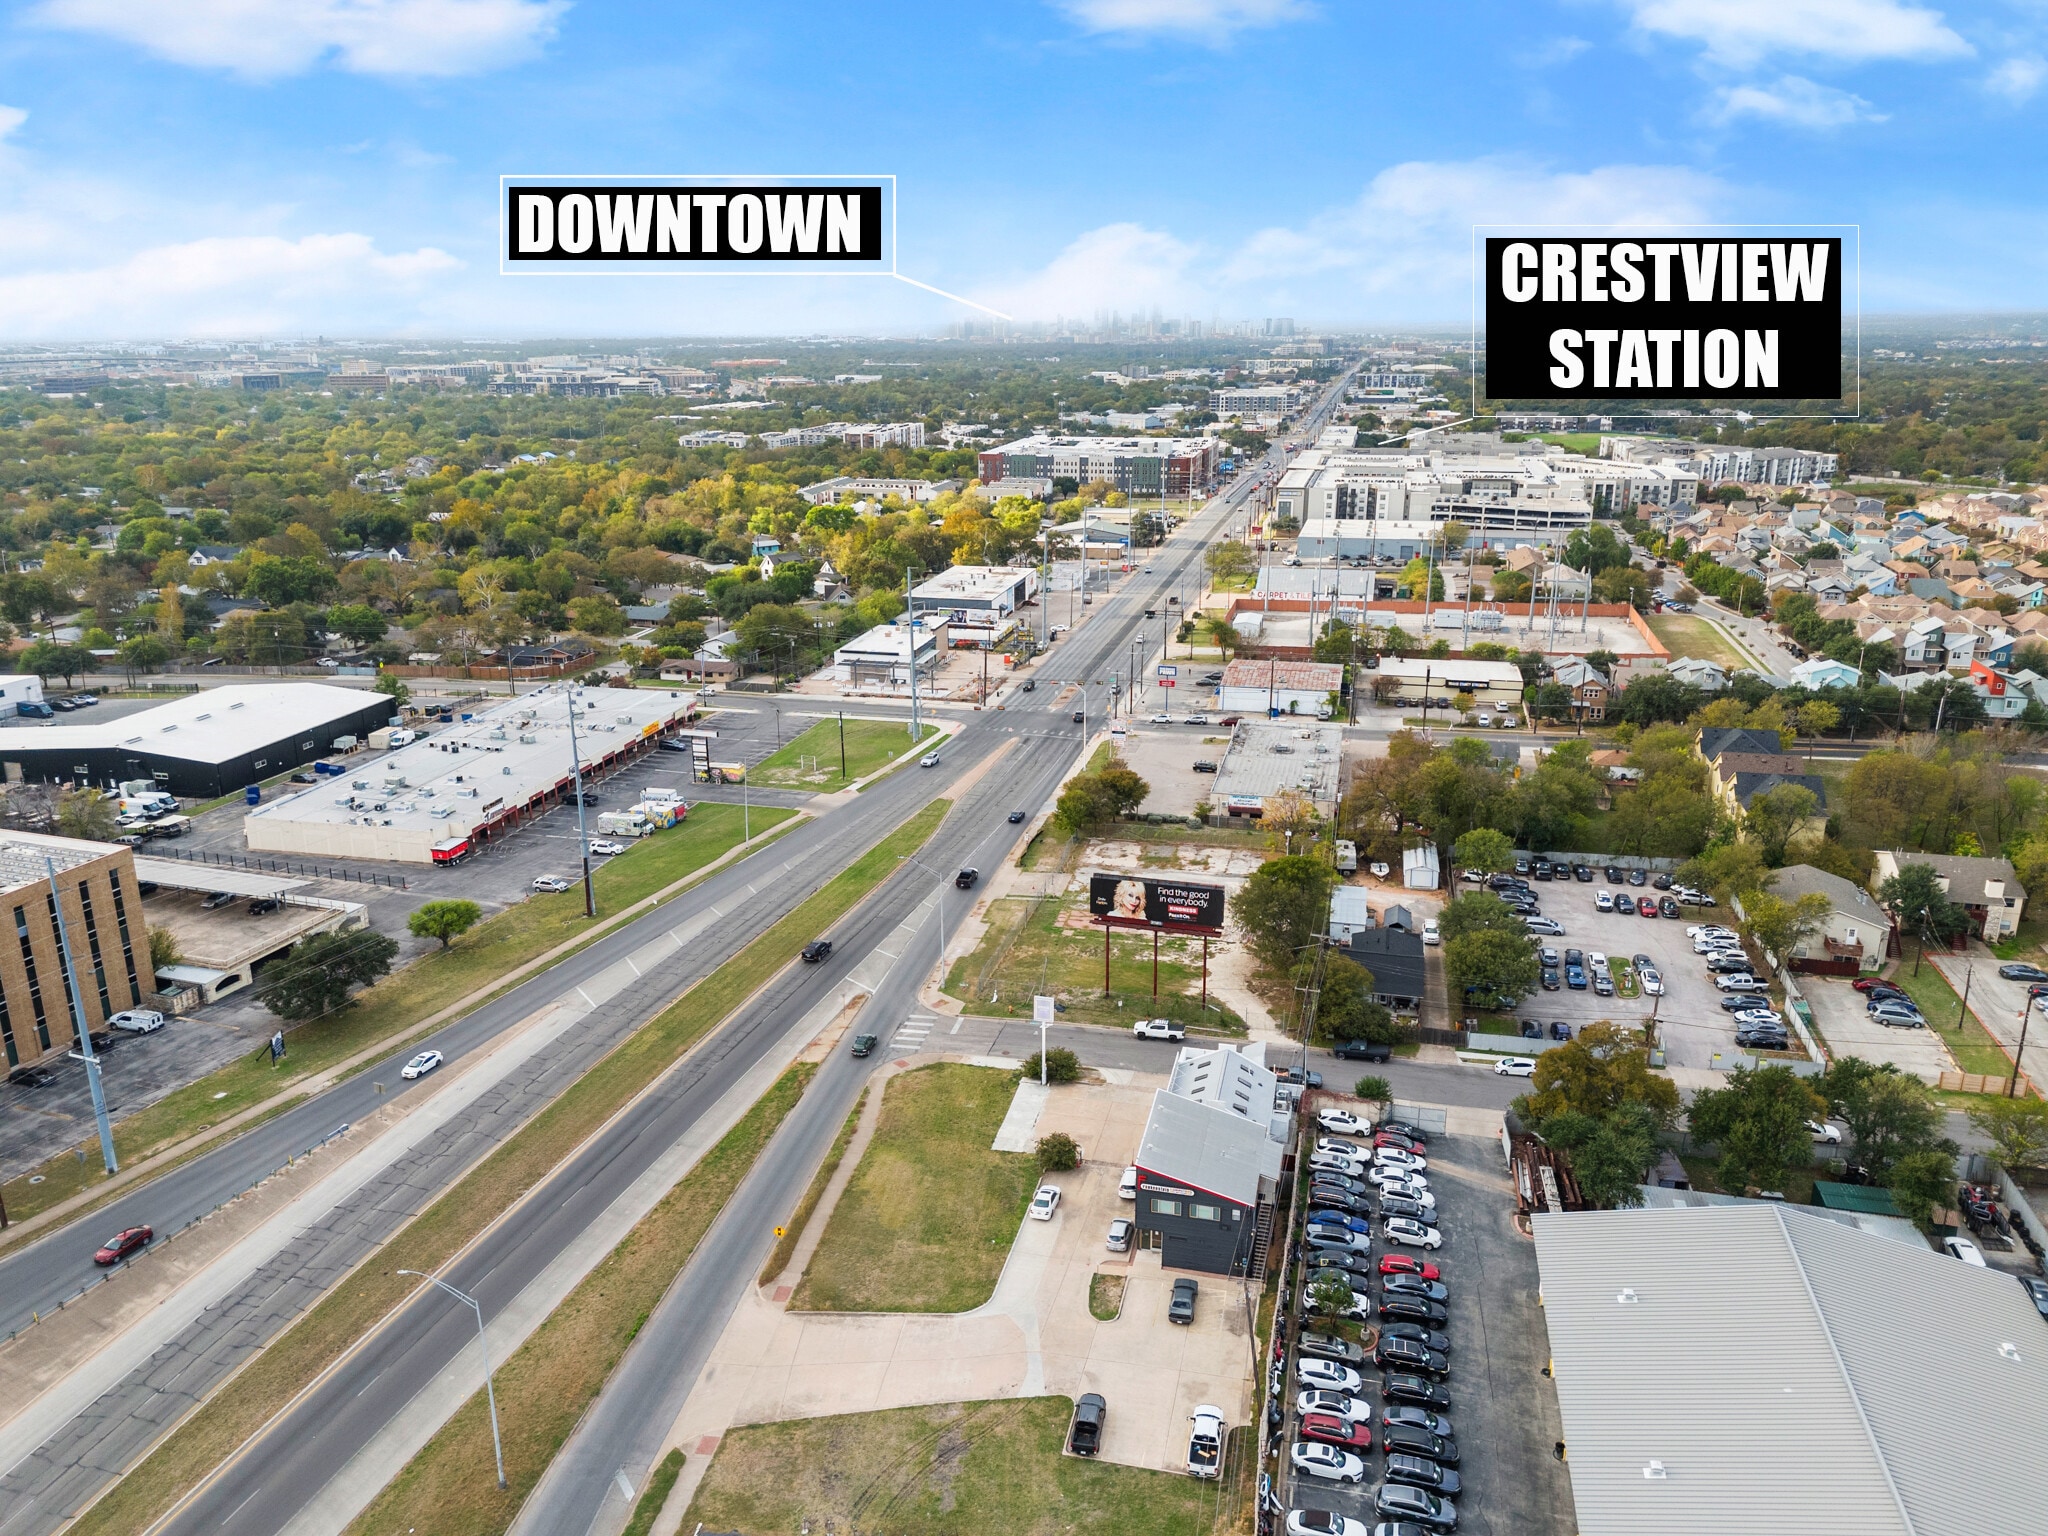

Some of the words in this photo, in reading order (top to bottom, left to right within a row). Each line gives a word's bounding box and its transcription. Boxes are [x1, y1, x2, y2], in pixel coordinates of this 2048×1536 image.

[1257, 591, 1288, 599] CARPET
[1158, 887, 1174, 896] Find
[1175, 889, 1188, 897] the
[1189, 891, 1210, 900] good
[1159, 895, 1167, 903] in
[1168, 897, 1209, 908] everybody.
[1169, 906, 1197, 914] KINDNESS
